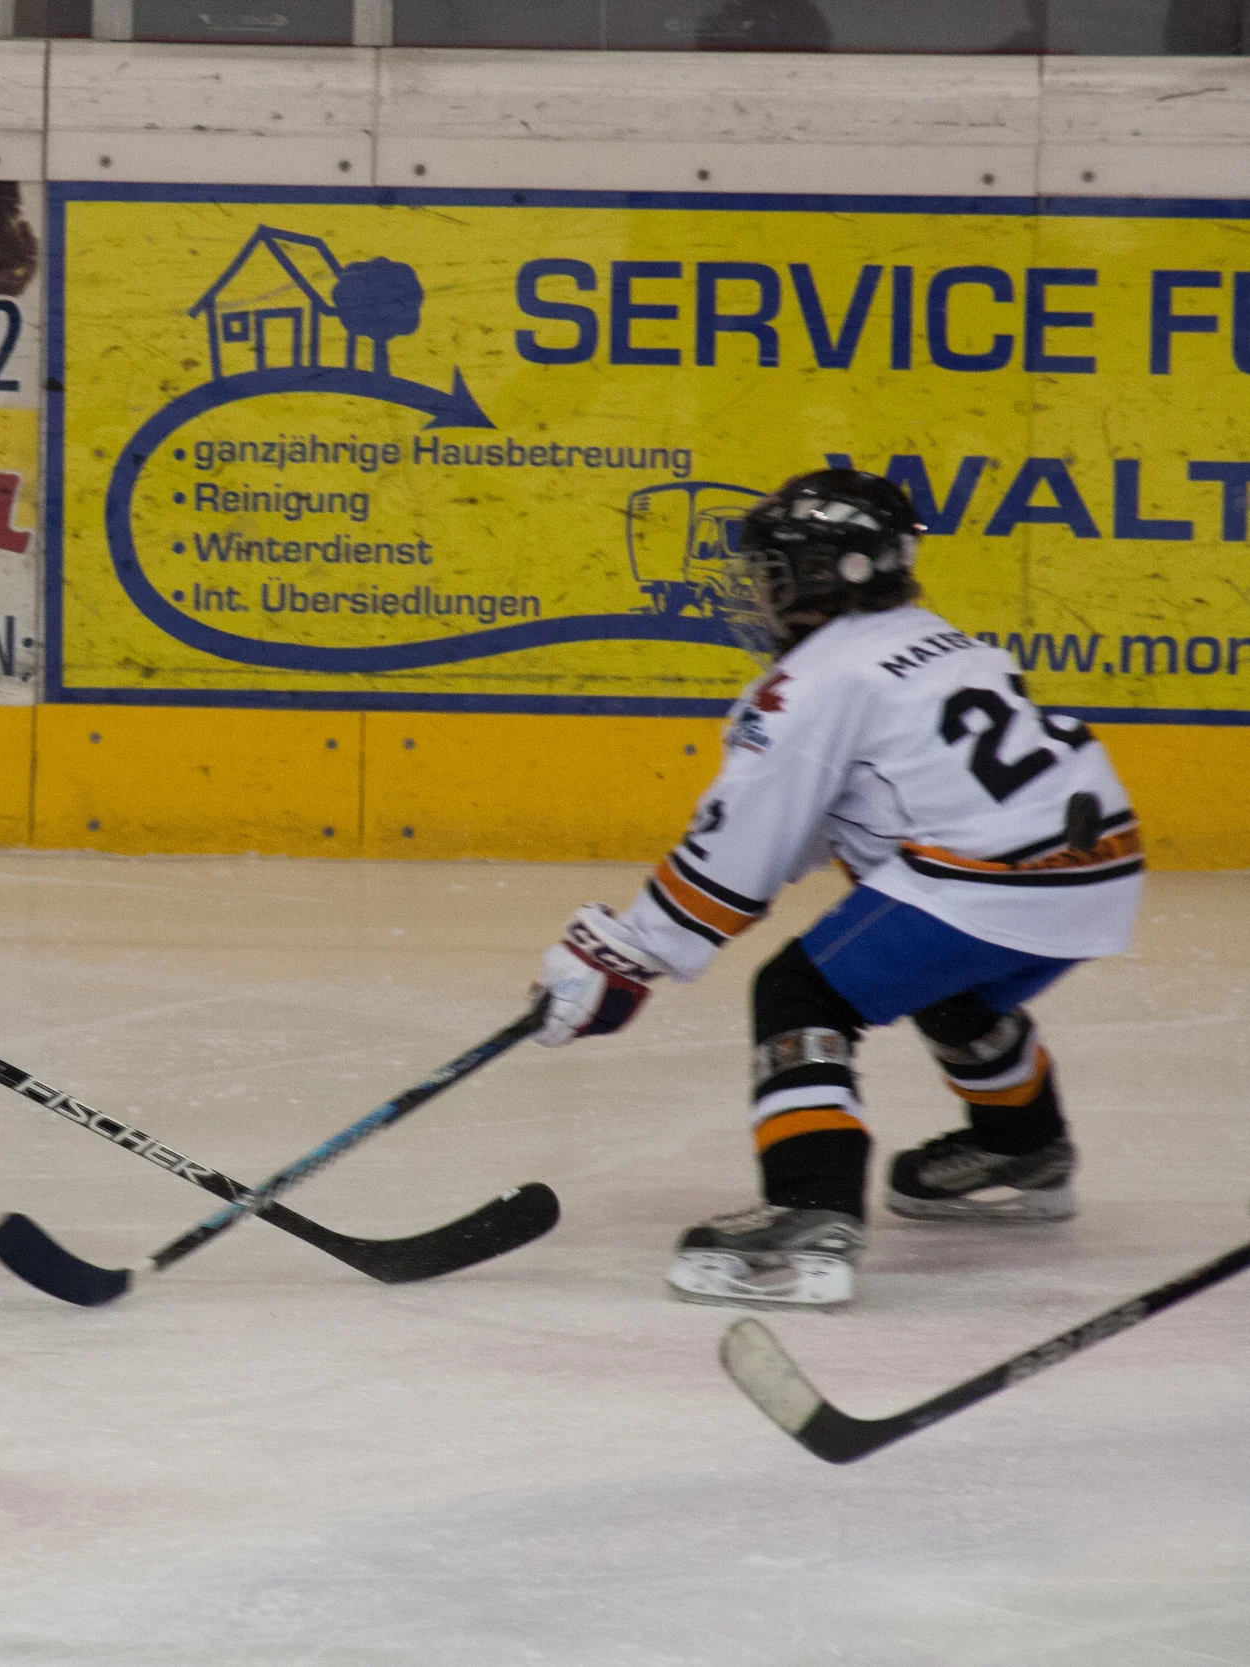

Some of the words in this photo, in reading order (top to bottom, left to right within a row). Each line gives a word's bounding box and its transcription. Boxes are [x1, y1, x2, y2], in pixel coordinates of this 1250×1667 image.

[514, 257, 1098, 375] SERVICE
[193, 433, 400, 473] ganzjährige
[412, 435, 692, 479] Hausbetreuung
[193, 481, 371, 523] Reinigung
[192, 532, 434, 565] Winterdienst
[192, 582, 249, 613] Int.
[261, 576, 542, 625] Übersiedlungen
